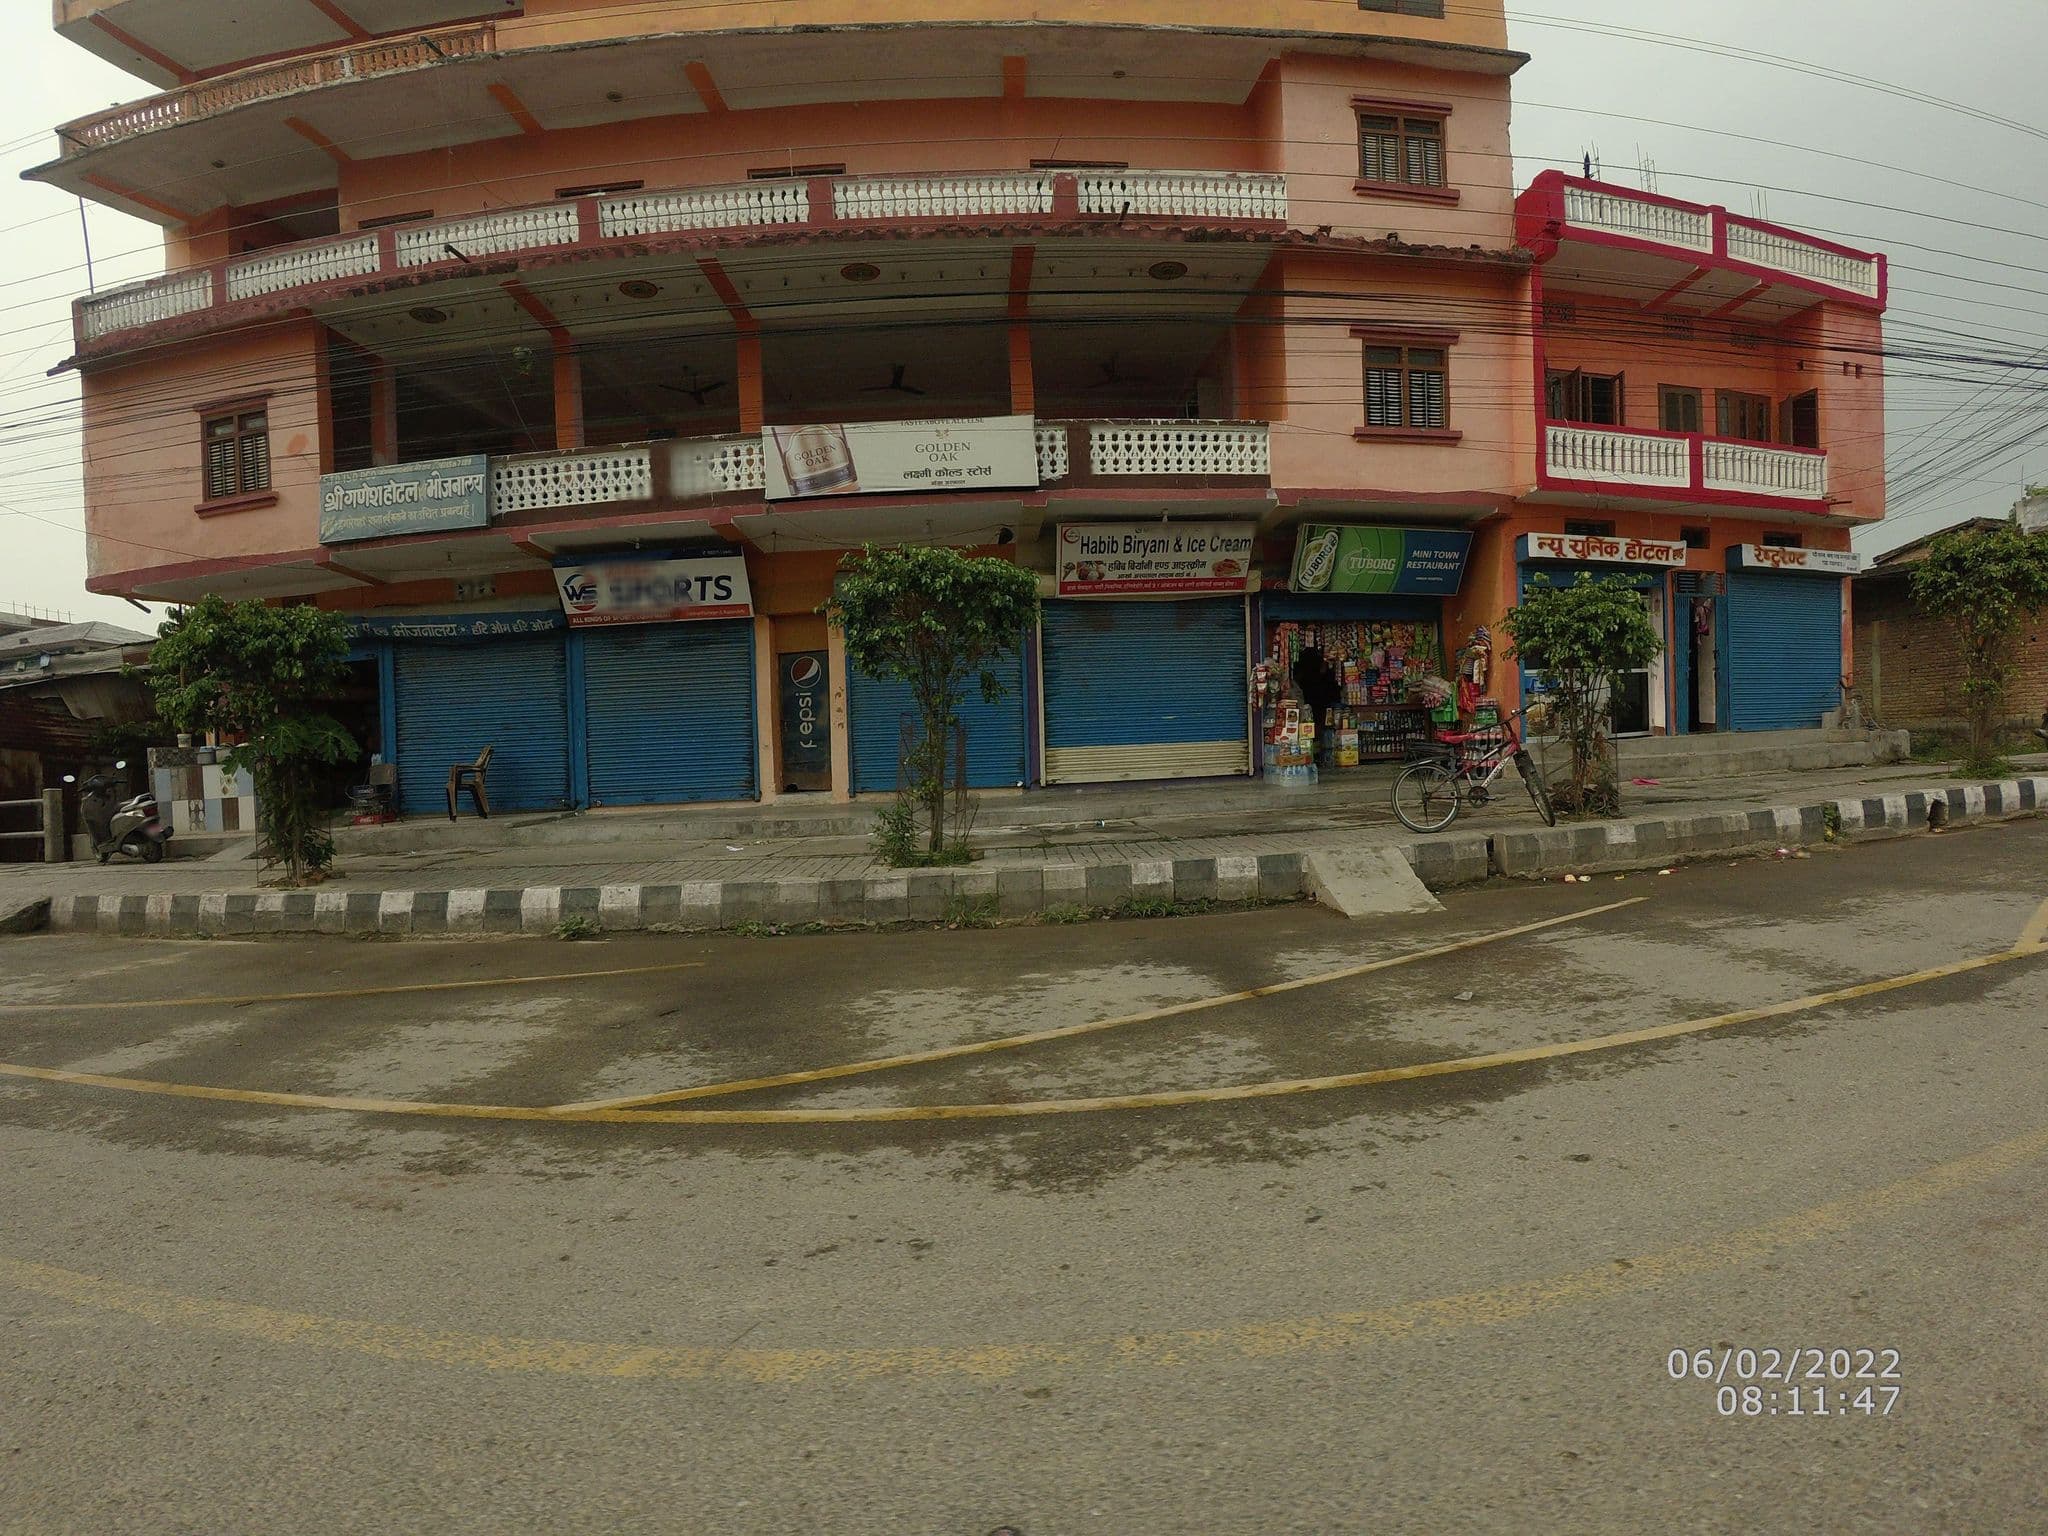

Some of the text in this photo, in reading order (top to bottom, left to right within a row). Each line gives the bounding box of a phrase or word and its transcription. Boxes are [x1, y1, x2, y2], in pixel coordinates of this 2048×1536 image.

[794, 444, 836, 462] GOLDEN
[915, 441, 971, 454] GOLDEN
[806, 455, 830, 468] OAK
[928, 452, 958, 463] OAK
[935, 467, 963, 480] कोल्ड
[966, 465, 992, 478] स्टोर्स
[426, 470, 485, 499] भोजनालय
[1080, 535, 1119, 555] Habib
[1123, 534, 1170, 559] Biryani
[1173, 536, 1184, 553] &
[1187, 537, 1206, 553] Ice
[1210, 535, 1252, 552] Cream
[1537, 536, 1565, 557] न्यू
[1569, 536, 1620, 559] युनिक
[1412, 550, 1460, 560] MINI TOWN
[1301, 542, 1334, 584] TUBORG
[1350, 557, 1397, 571] TUBORG
[1406, 561, 1461, 571] RESTAURANT
[392, 622, 457, 638] भोजनालय
[472, 622, 488, 635] हरि
[491, 620, 511, 635] ओम
[512, 619, 528, 633] हरि
[532, 618, 554, 632] ओम
